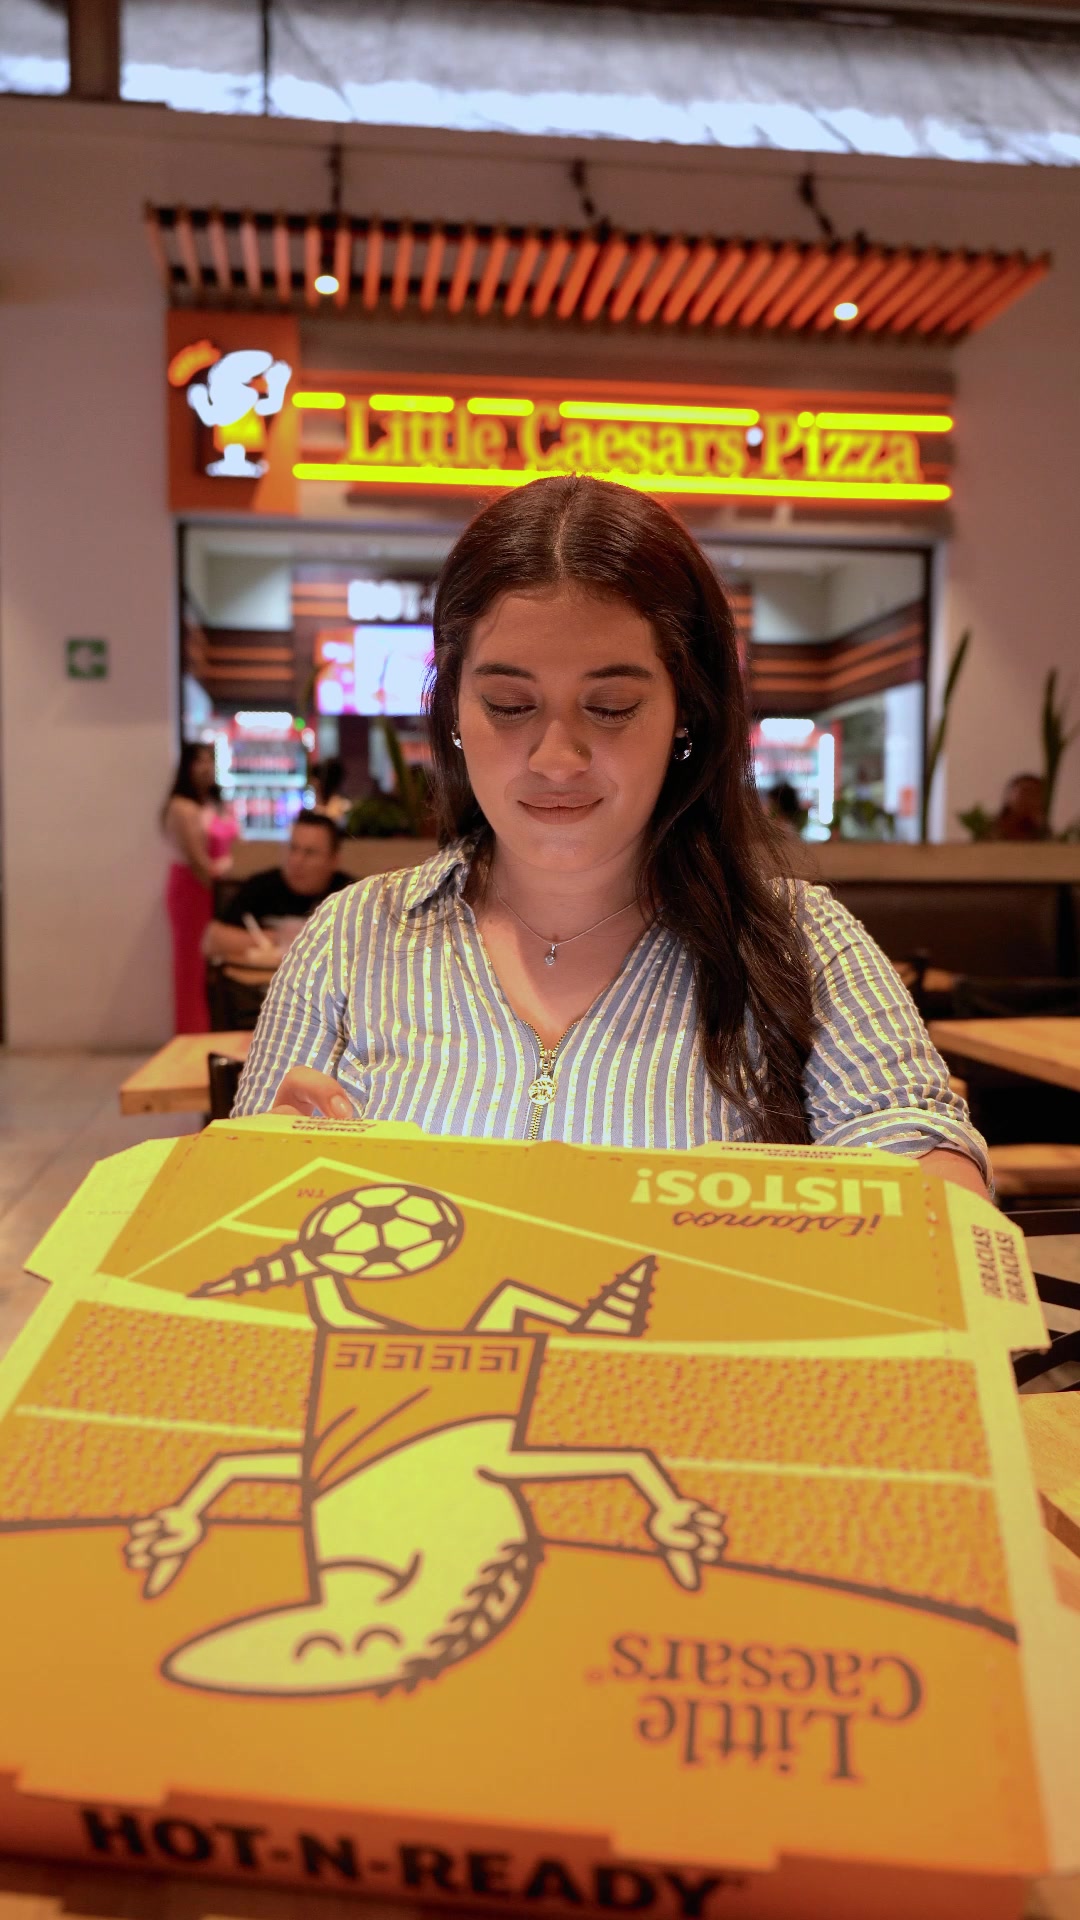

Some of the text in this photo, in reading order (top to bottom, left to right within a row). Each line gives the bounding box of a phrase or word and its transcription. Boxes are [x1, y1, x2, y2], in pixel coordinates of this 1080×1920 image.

[346, 401, 920, 480] Little Caesars Pizza
[630, 1168, 903, 1217] LISTOS!
[672, 1211, 881, 1237] ¡Estamos
[611, 1635, 923, 1722] Caesars
[636, 1695, 862, 1781] Little
[79, 1809, 726, 1919] HOT-N-READY
